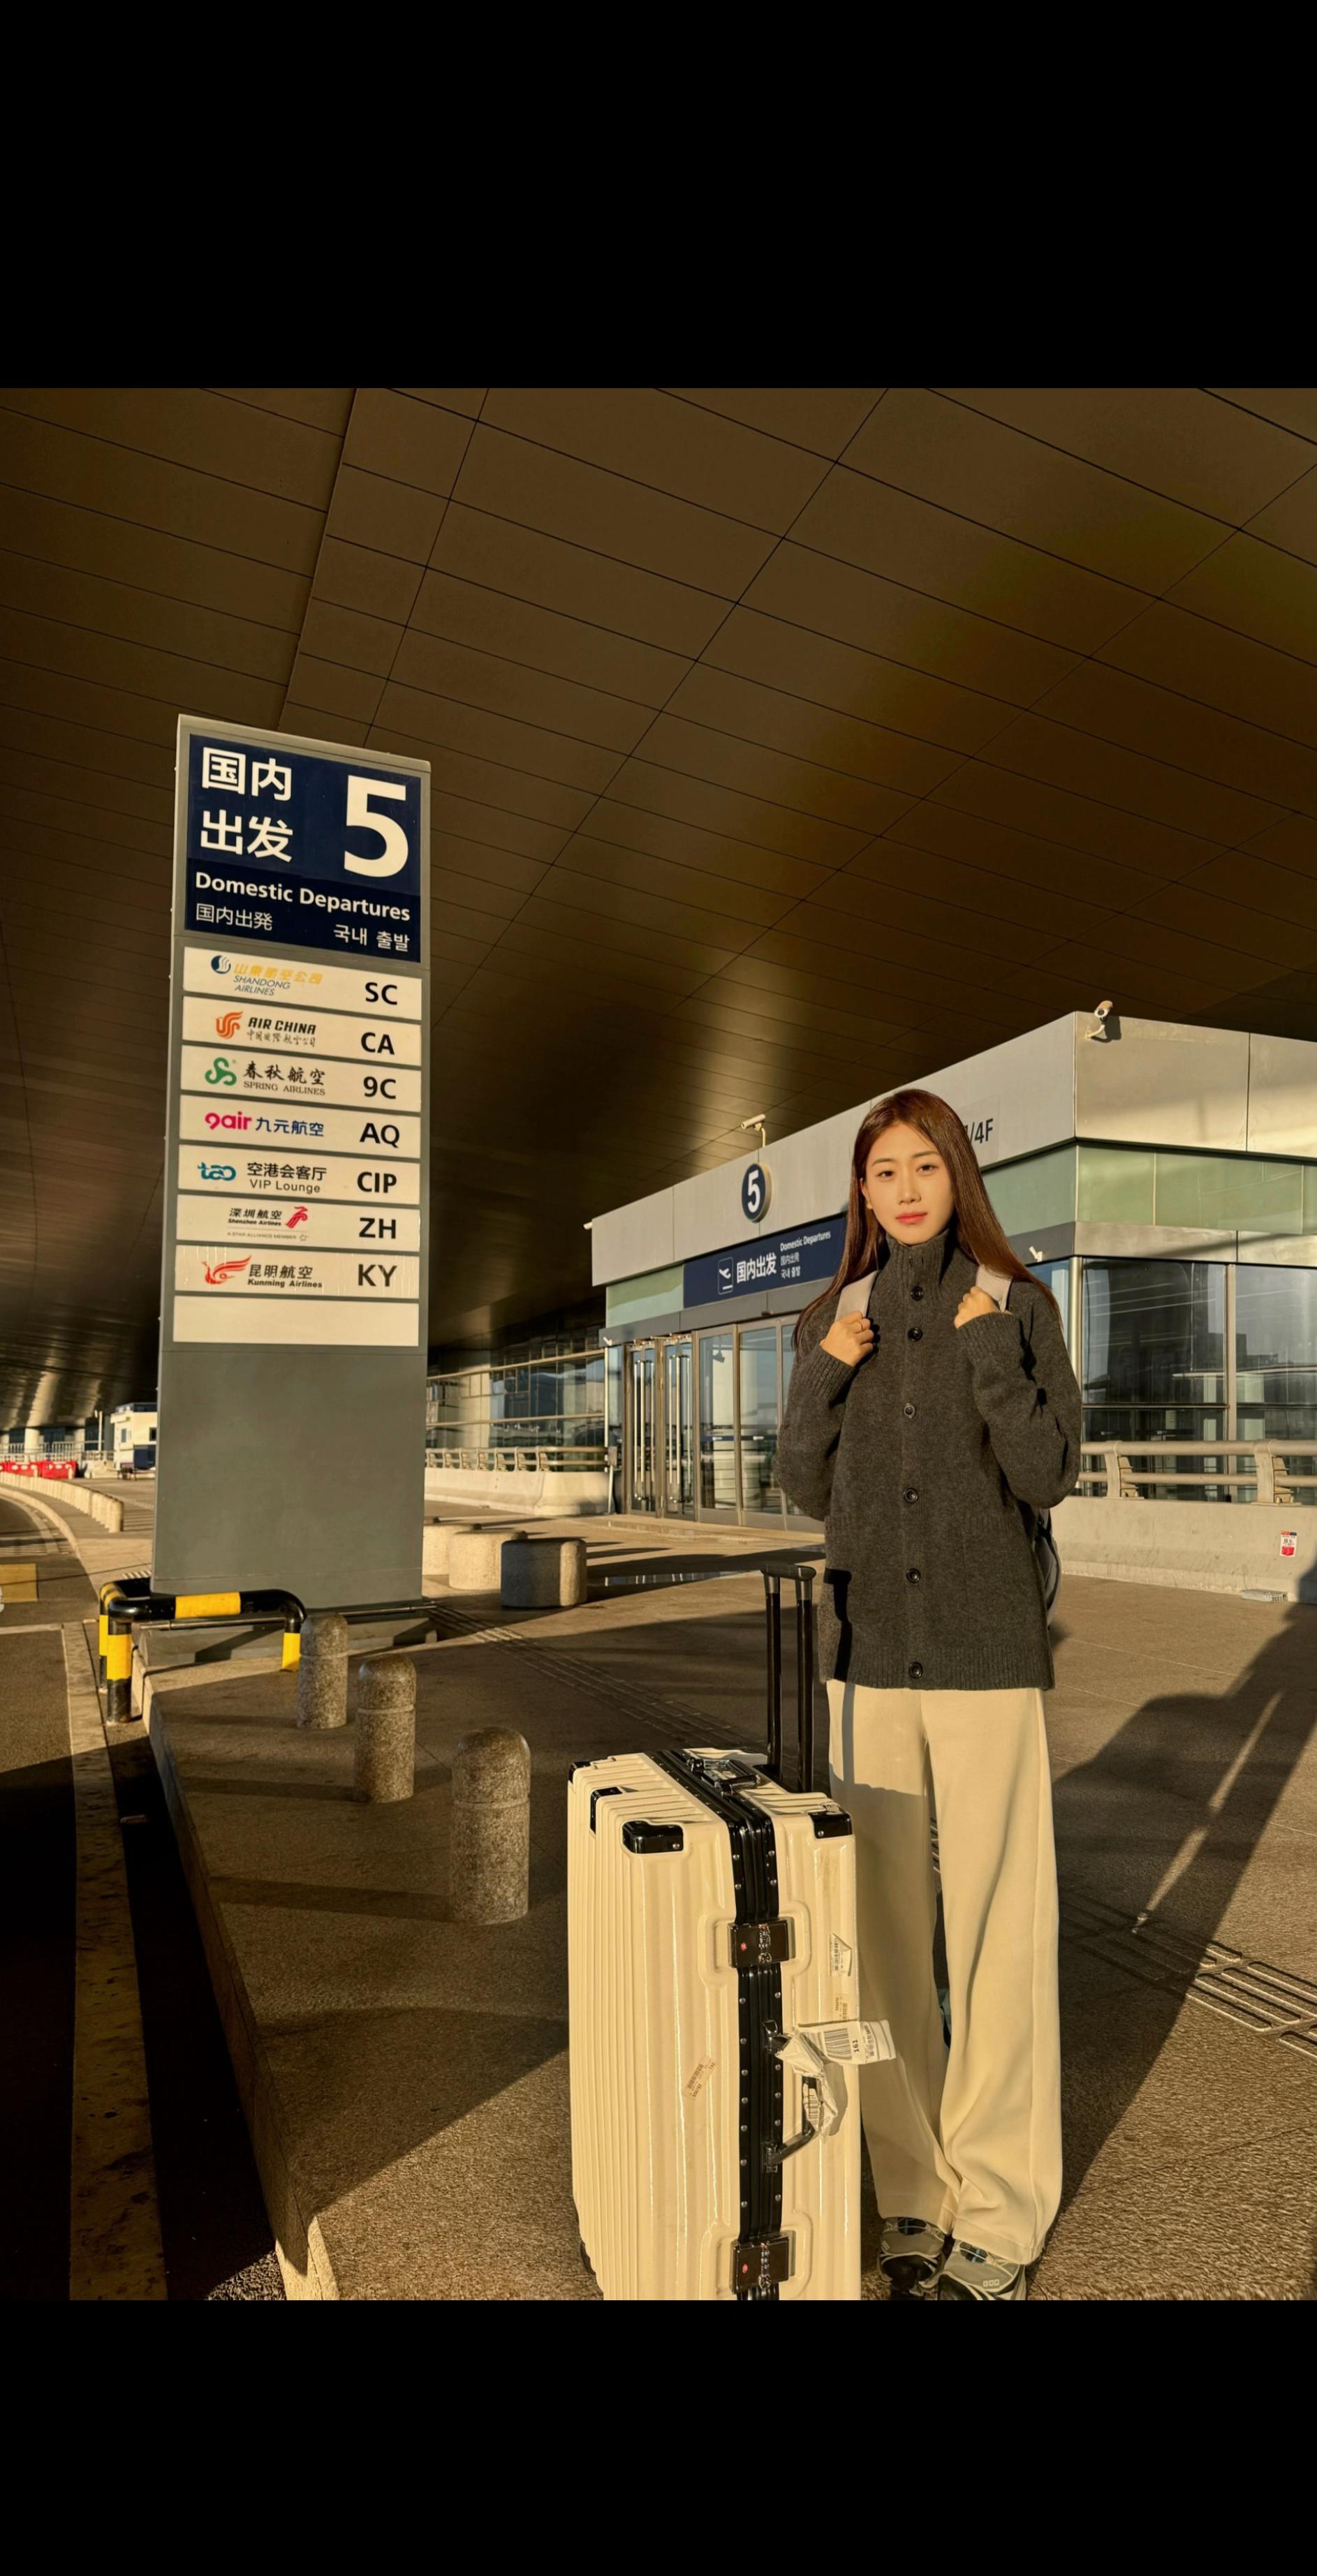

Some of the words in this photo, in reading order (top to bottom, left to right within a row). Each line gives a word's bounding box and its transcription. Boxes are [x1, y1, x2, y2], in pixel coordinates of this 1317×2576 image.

[202, 746, 292, 801] 国内
[200, 809, 293, 862] 出发
[344, 774, 409, 878] 5
[196, 871, 293, 902] Domestic
[300, 888, 410, 921] Departures
[196, 903, 273, 931] 国内出発
[333, 924, 367, 945] 국내
[376, 931, 409, 952] 출발
[233, 975, 290, 989] SHANDONG
[235, 984, 275, 996] AIRLINES
[365, 982, 397, 1005] SC
[248, 1017, 272, 1030] AIR
[275, 1020, 316, 1035] CHINA
[360, 1032, 395, 1055] CA
[243, 1060, 325, 1086] 春秋航空
[243, 1081, 278, 1091] SPRING
[283, 1086, 325, 1095] AIRLINES
[363, 1076, 396, 1099] 9C
[205, 1111, 252, 1130] 9air
[256, 1117, 324, 1137] 九元航空
[360, 1123, 399, 1148] AQ
[247, 1162, 327, 1181] 空港会客厅
[357, 1171, 397, 1193] CIP
[250, 1179, 271, 1189] VIP
[276, 1180, 321, 1194] Lounge
[747, 1169, 760, 1213] 5
[229, 1208, 282, 1220] 深圳航空
[359, 1217, 396, 1239] ZH
[780, 1237, 802, 1252] Domestic
[803, 1231, 831, 1245] Departures
[249, 1264, 313, 1279] 昆明航空
[358, 1264, 397, 1287] KY
[737, 1252, 777, 1283] 国内出发
[247, 1279, 285, 1288] Kunming
